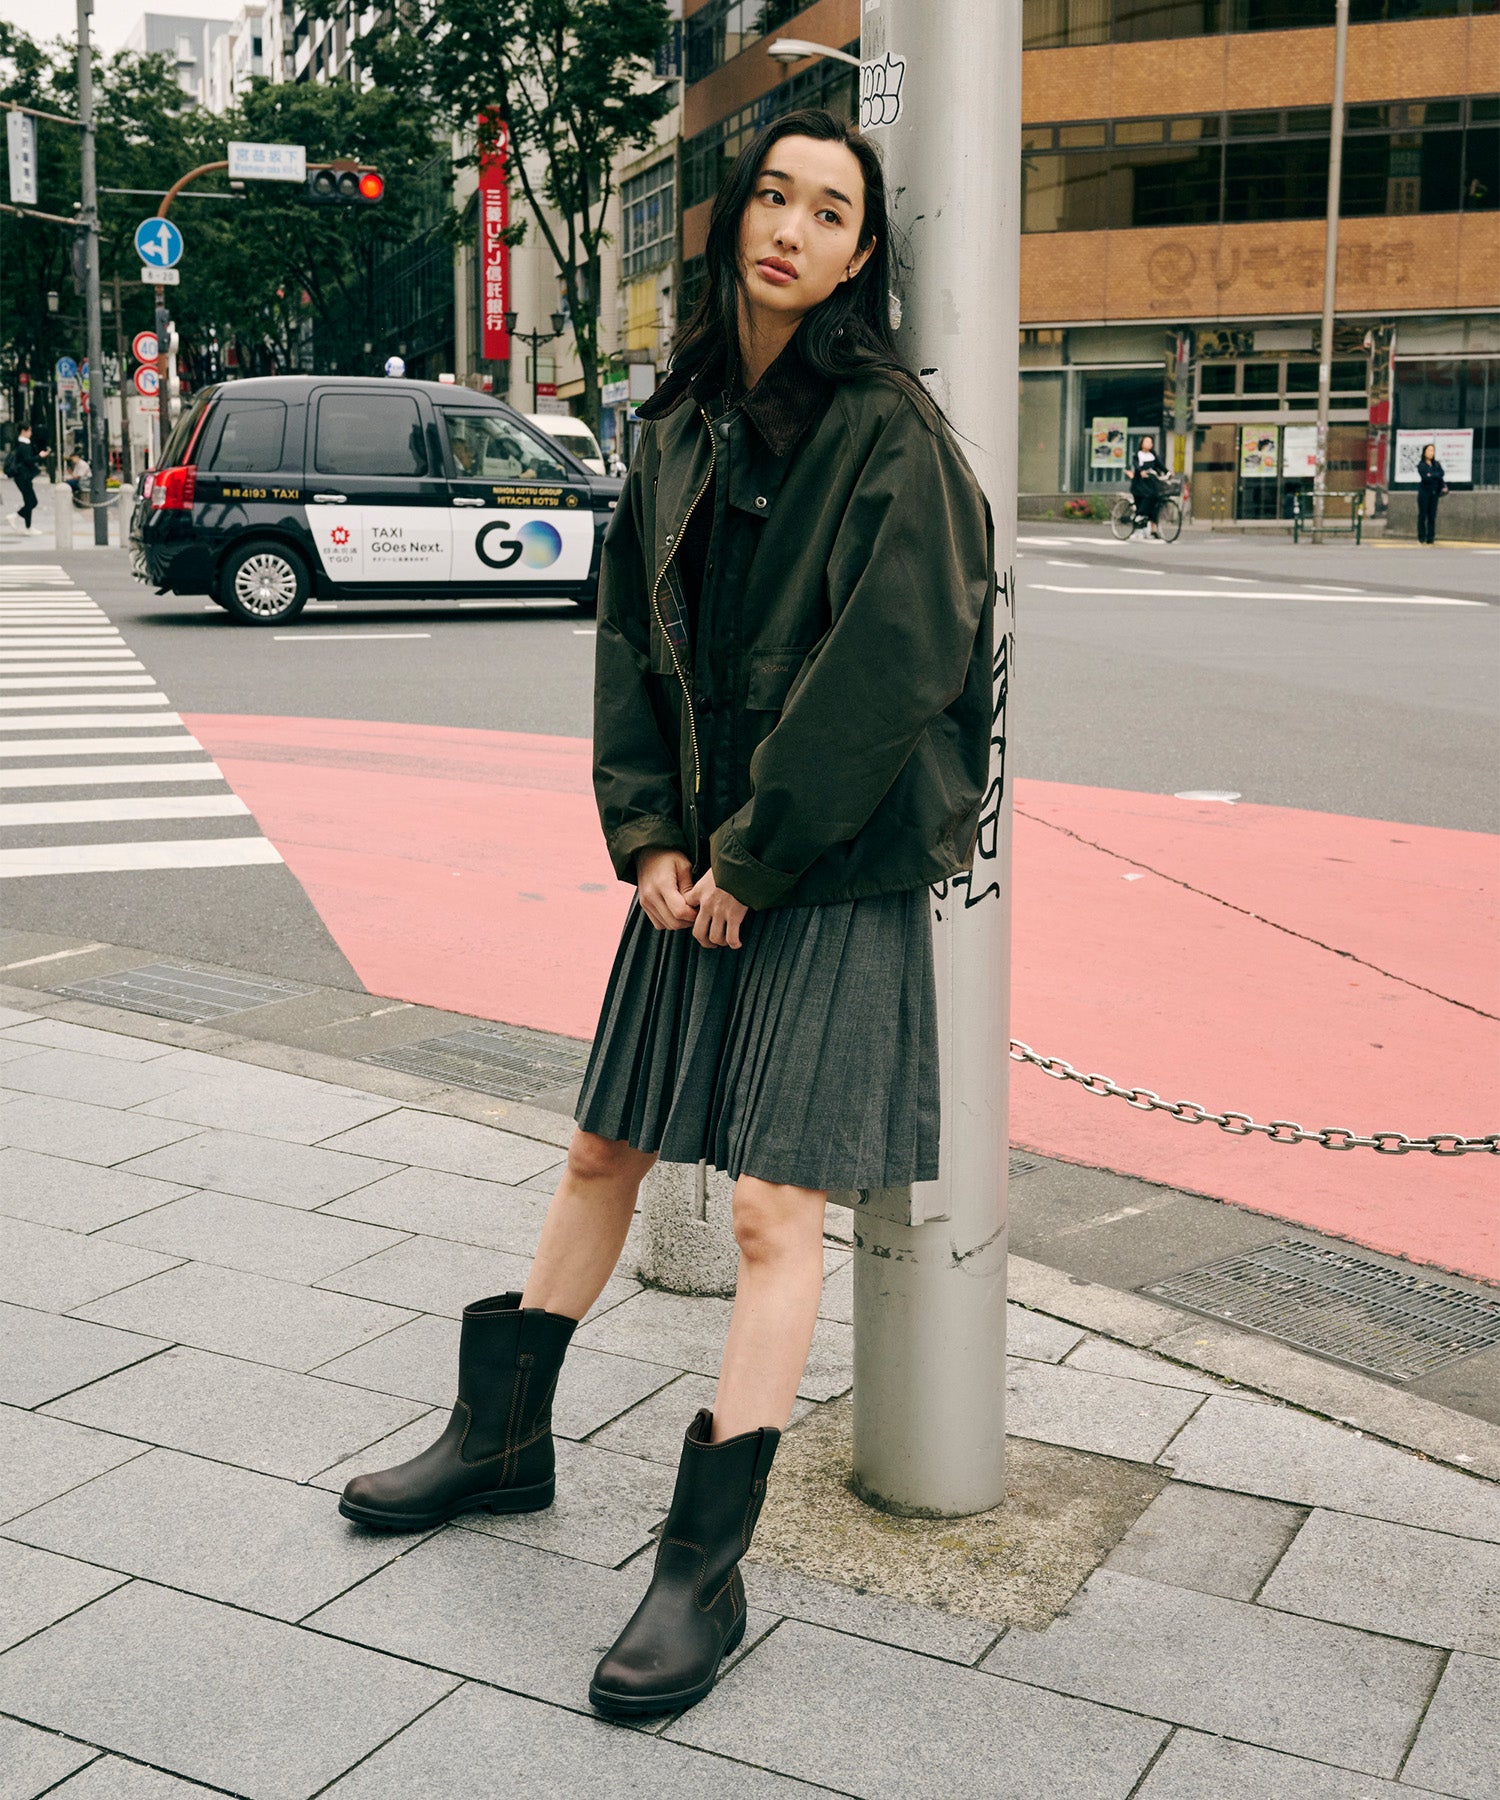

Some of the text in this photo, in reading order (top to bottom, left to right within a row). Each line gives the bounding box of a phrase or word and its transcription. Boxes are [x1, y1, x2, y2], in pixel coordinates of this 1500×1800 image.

[486, 189, 502, 331] 三菱UFJ信託銀行
[141, 342, 158, 355] 40
[272, 489, 299, 499] TAXI
[515, 488, 538, 496] KOTSU
[538, 489, 563, 497] GROUP
[497, 496, 559, 507] HITACHI KOTSU
[371, 527, 403, 538] TAXI
[371, 542, 444, 553] GOes Next.
